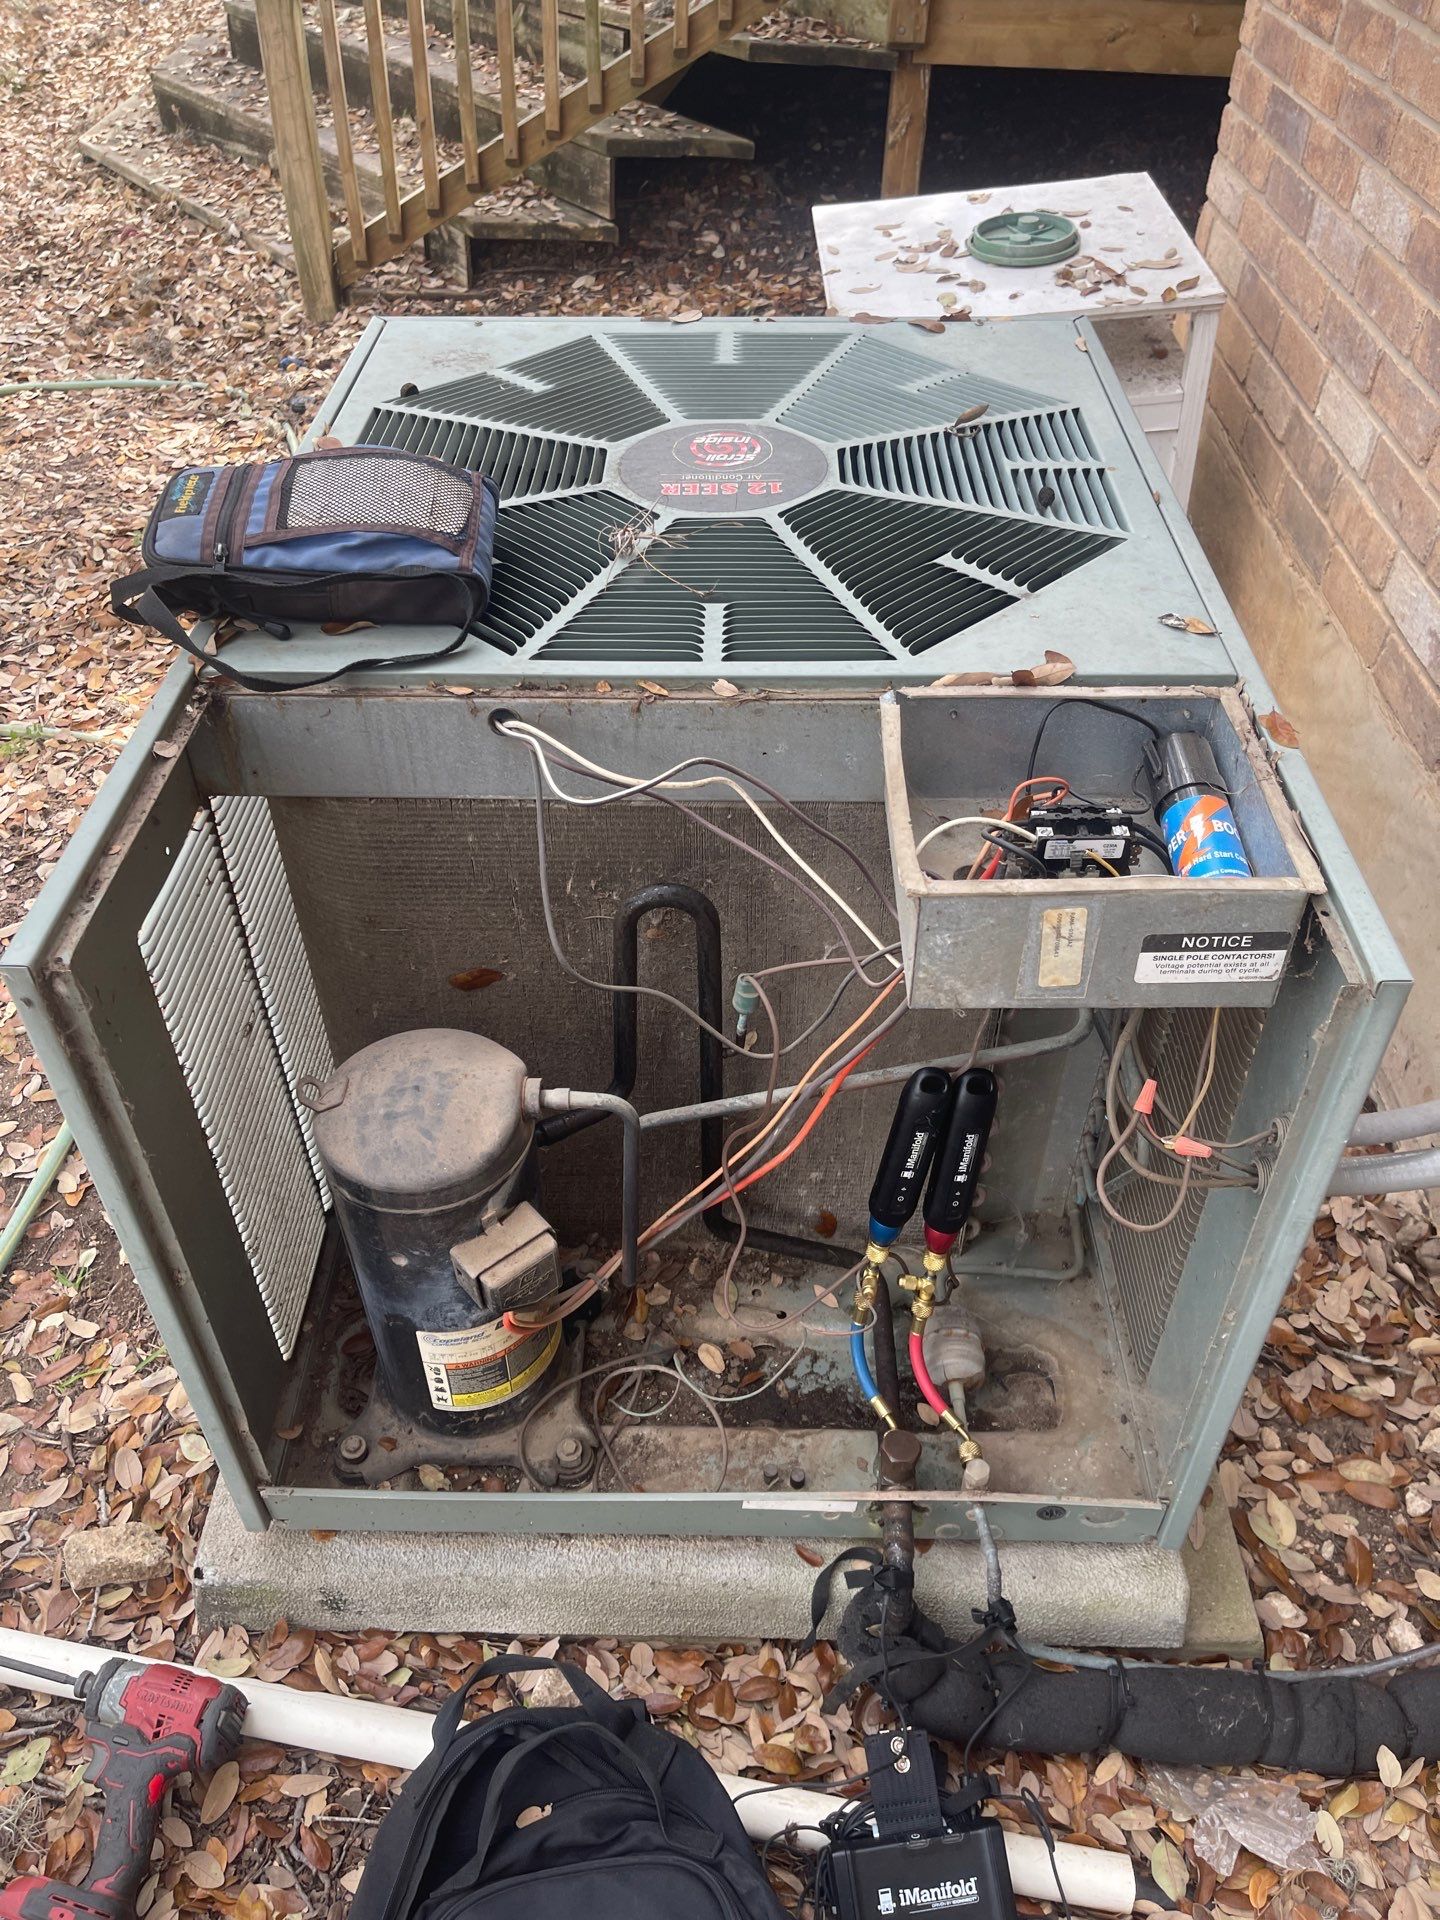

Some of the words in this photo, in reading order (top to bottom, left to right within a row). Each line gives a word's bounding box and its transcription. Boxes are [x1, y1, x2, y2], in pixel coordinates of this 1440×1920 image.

[661, 482, 739, 495] SEER
[748, 482, 783, 495] 12
[1213, 850, 1235, 859] Start
[1181, 935, 1254, 949] NOTICE
[1211, 953, 1276, 961] CONTACTORS!
[1186, 962, 1221, 970] potential
[1198, 968, 1223, 976] during
[904, 1132, 925, 1169] iManifold
[957, 1134, 975, 1173] iManifold
[461, 1355, 498, 1368] WARNING
[898, 1877, 978, 1907] iManifold
